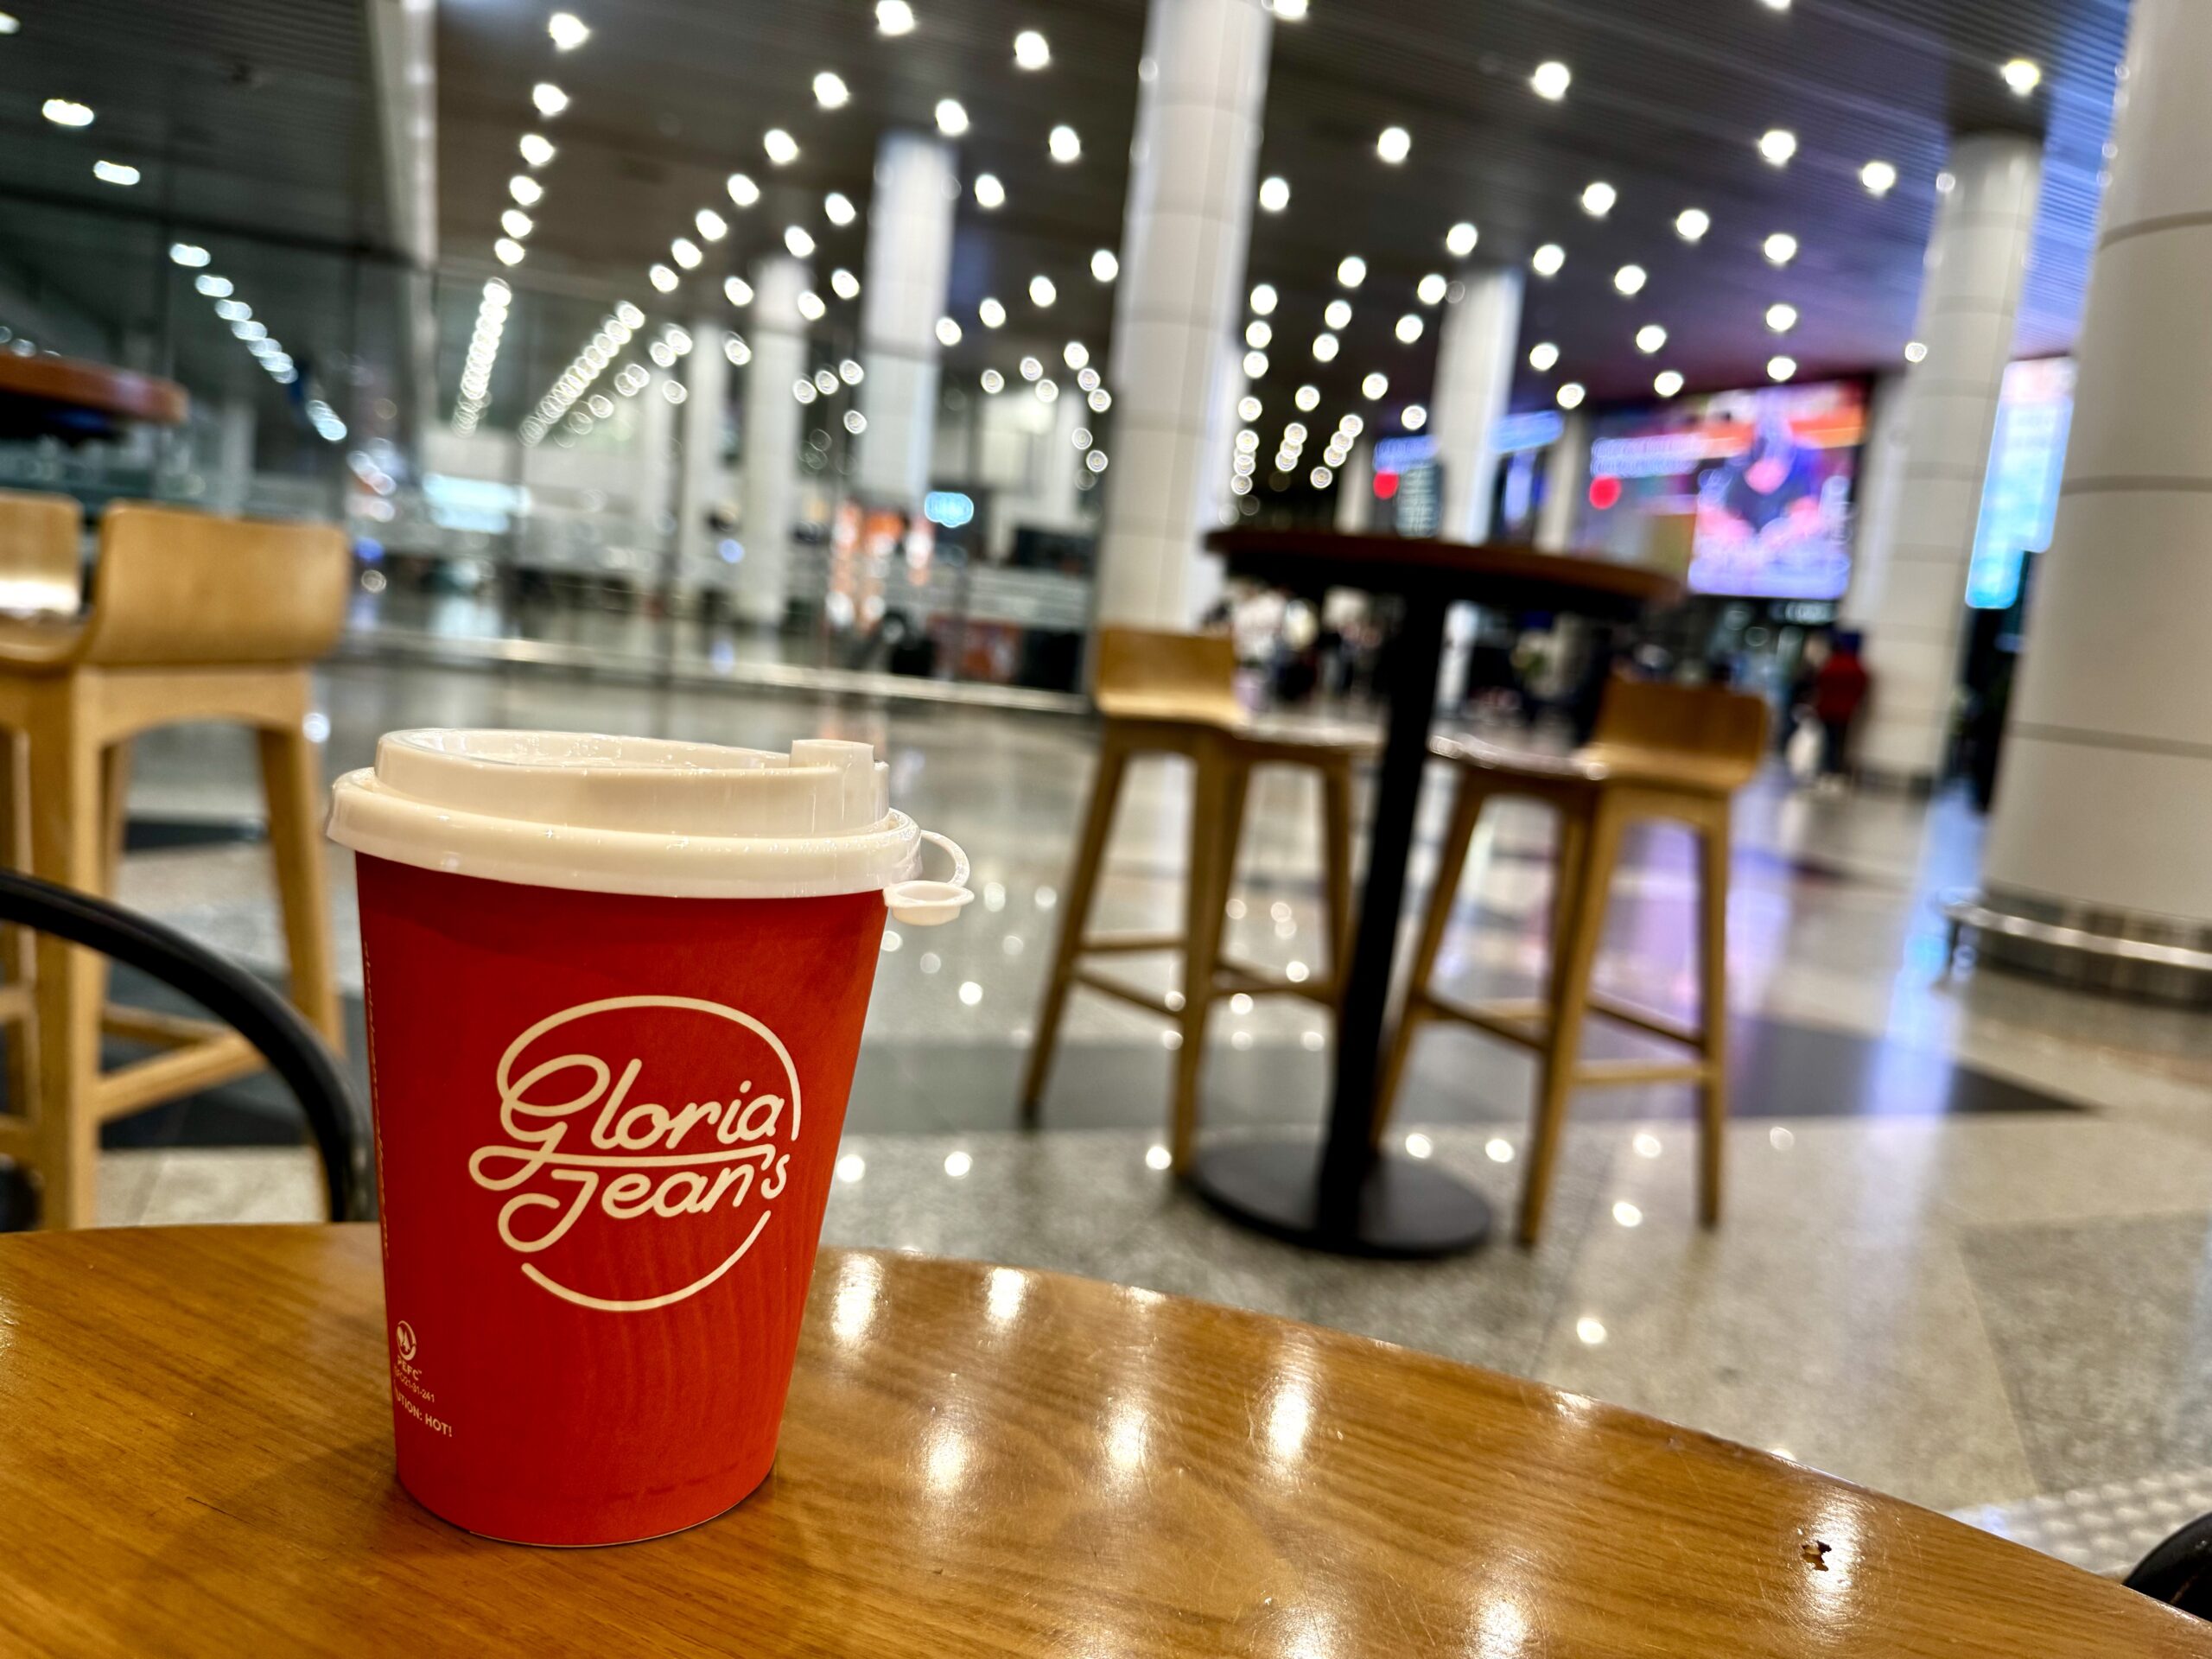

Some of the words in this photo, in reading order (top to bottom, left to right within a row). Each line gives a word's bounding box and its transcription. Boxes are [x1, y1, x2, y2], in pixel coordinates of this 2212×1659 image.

[468, 1053, 785, 1191] Gloria
[499, 1144, 790, 1252] Jean's
[425, 1413, 453, 1438] HOT!
